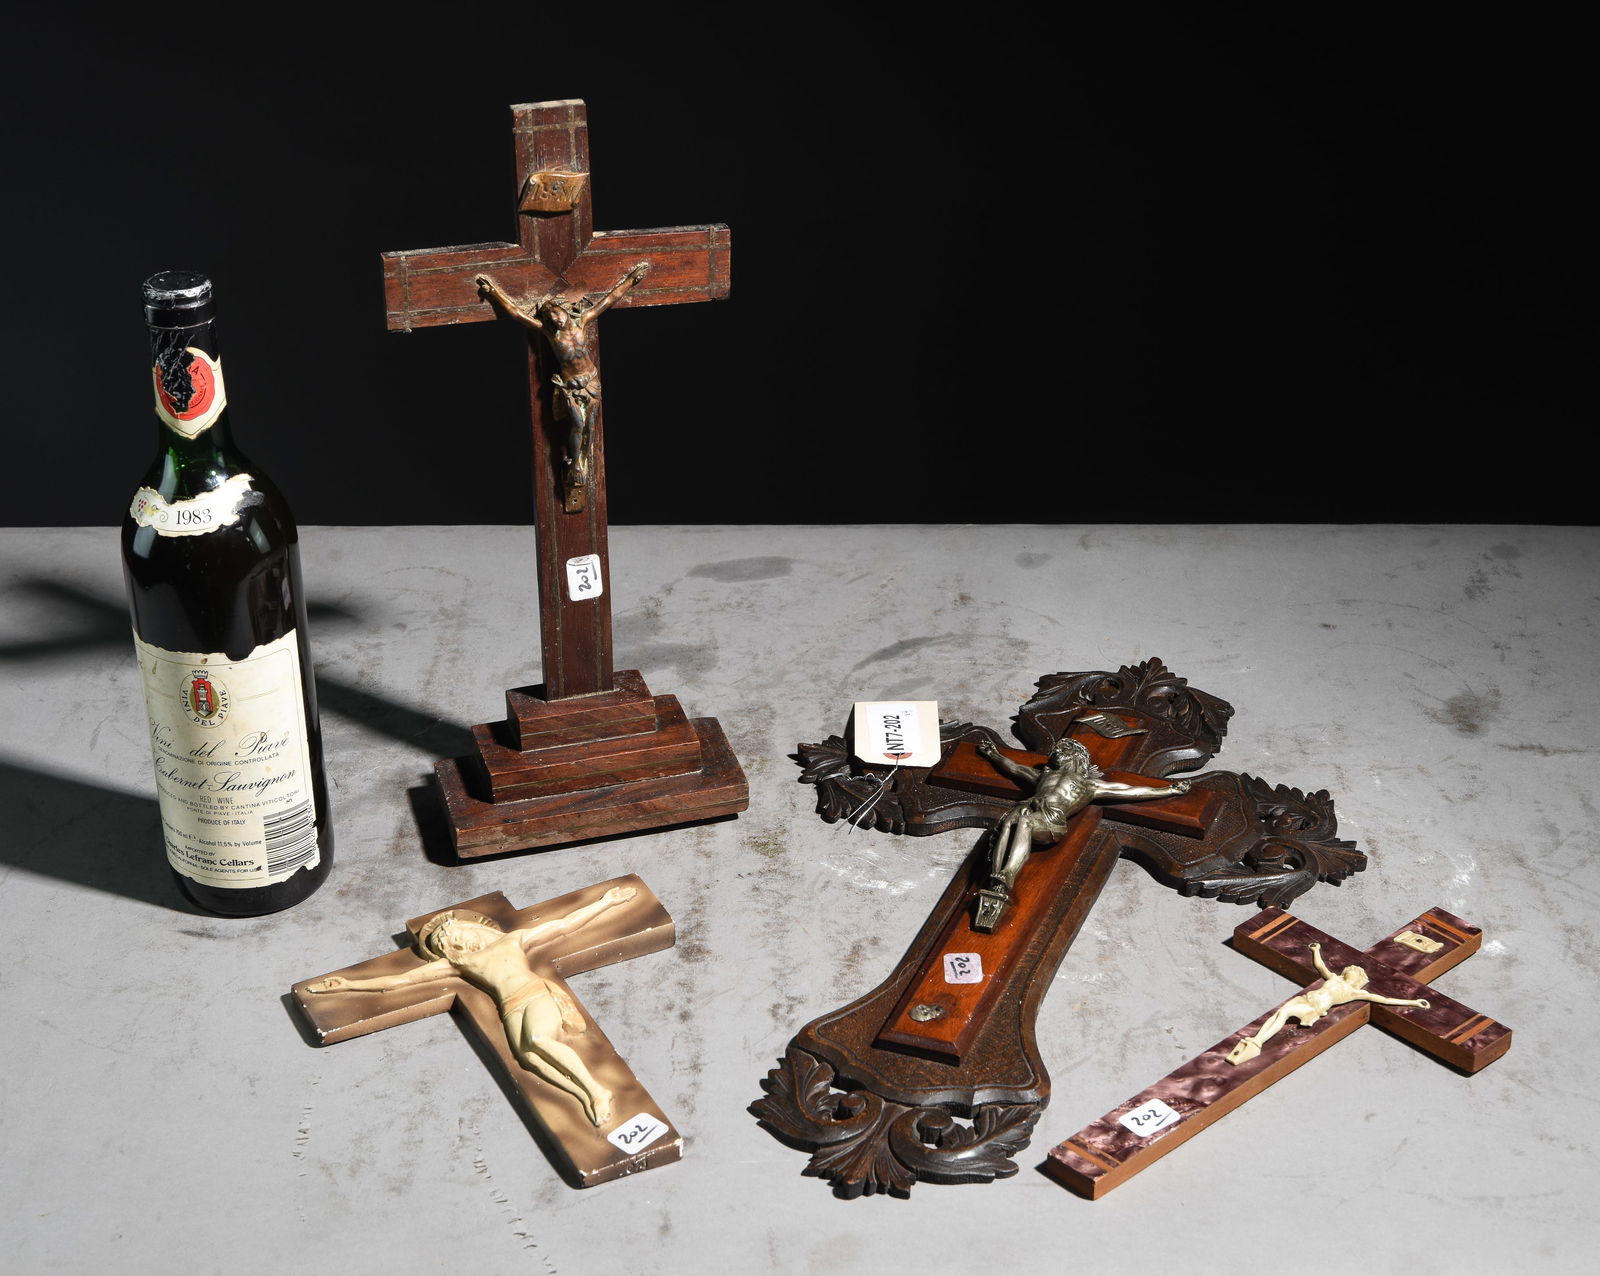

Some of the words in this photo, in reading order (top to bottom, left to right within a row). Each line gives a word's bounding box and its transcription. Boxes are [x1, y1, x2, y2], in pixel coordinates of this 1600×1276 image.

[176, 508, 212, 525] 1983
[181, 689, 192, 713] VINI
[193, 716, 216, 727] DEL
[217, 689, 229, 720] PIAVE
[883, 714, 905, 751] NT7-202
[189, 740, 226, 758] del
[234, 729, 289, 758] Piave
[234, 752, 280, 766] CONTROLLATA
[189, 802, 219, 811] BOTTLED
[230, 802, 261, 811] CANTINA
[199, 795, 212, 804] RED
[217, 796, 234, 805] WINE
[197, 817, 222, 826] PRODUCE
[185, 850, 218, 866] Lefranc
[219, 858, 255, 867] Cellars
[955, 957, 971, 976] 202
[1130, 1109, 1163, 1126] 202
[618, 1124, 649, 1144] 202
